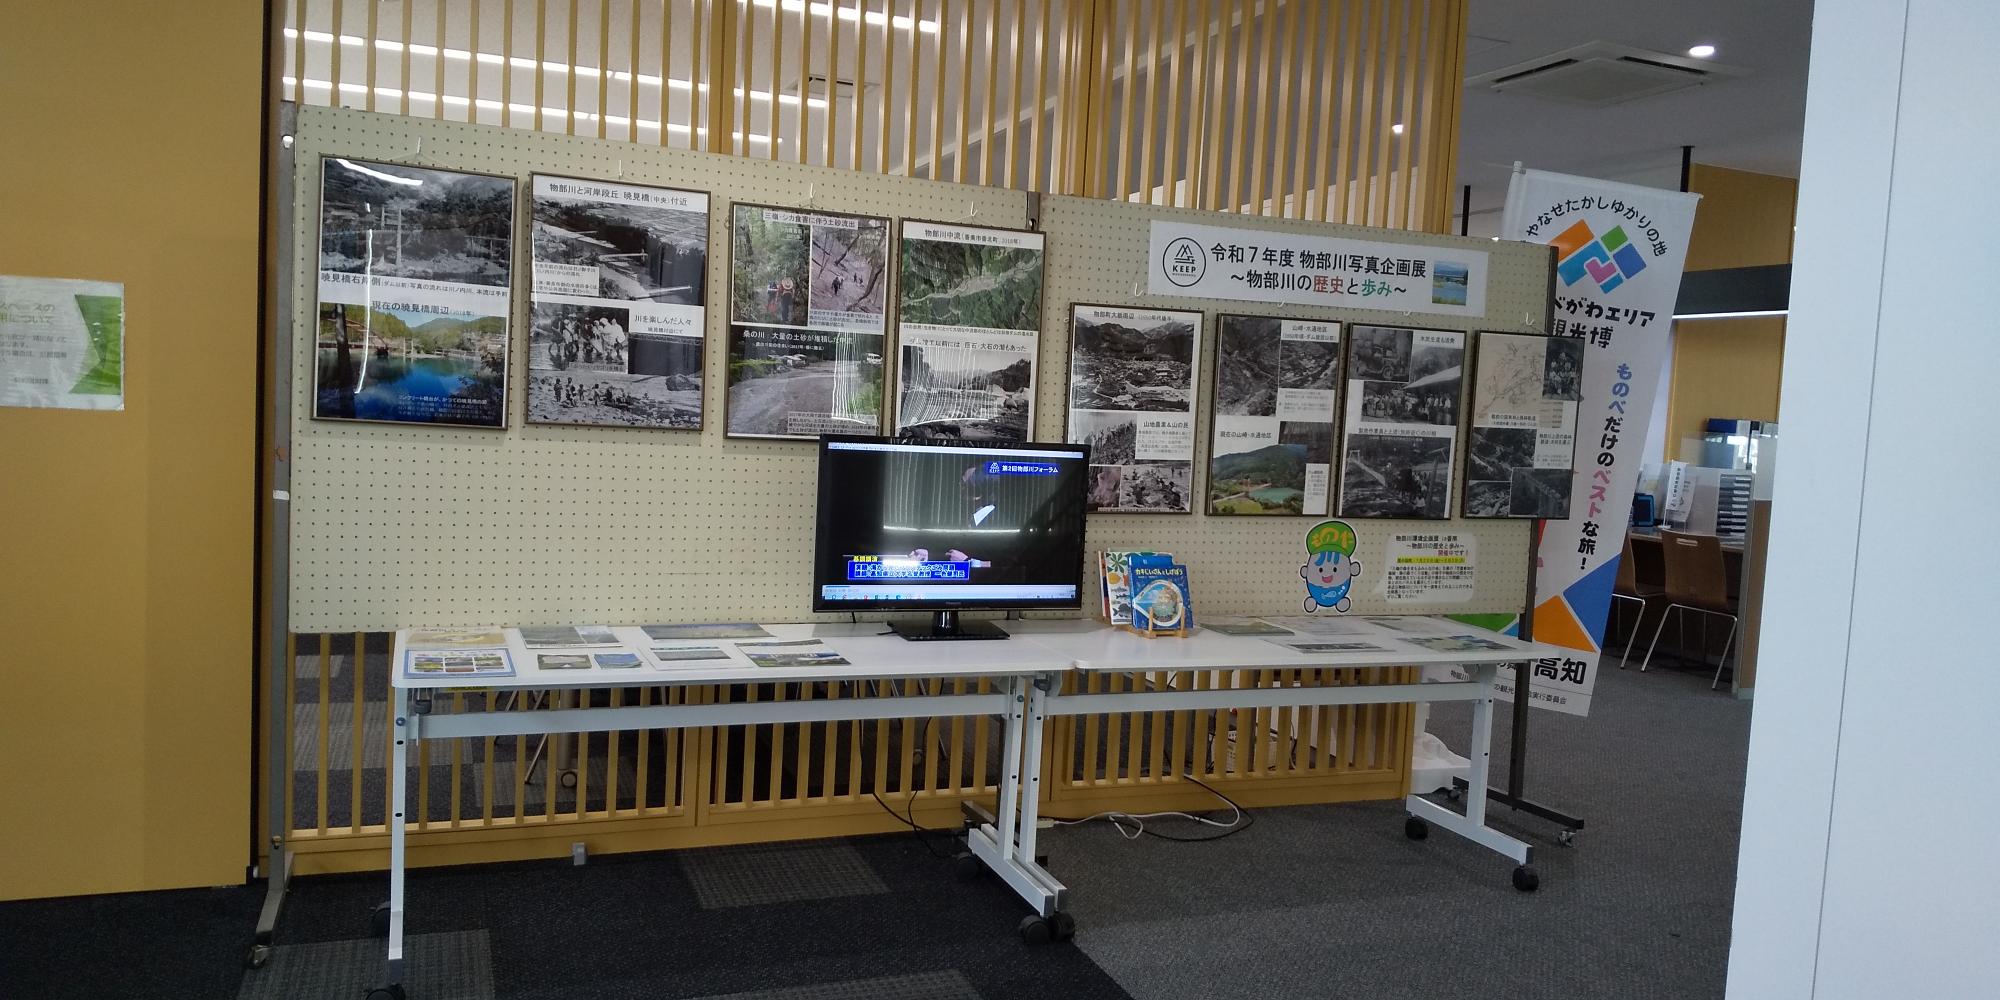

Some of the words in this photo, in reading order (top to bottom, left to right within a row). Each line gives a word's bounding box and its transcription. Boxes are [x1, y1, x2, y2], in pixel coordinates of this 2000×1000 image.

[549, 183, 619, 199] 物部川と河岸段丘
[1526, 196, 1668, 256] やなせたかしゆかりの地
[1210, 242, 1295, 269] 令和7年度
[1299, 248, 1427, 279] 物部川写真企画展
[1172, 265, 1197, 274] KEEP
[634, 314, 692, 326] 川を楽しんだ人々
[742, 329, 765, 339] 桑の川
[1001, 464, 1059, 474] 第2回物部川フォーラム
[1534, 656, 1587, 685] 高知
